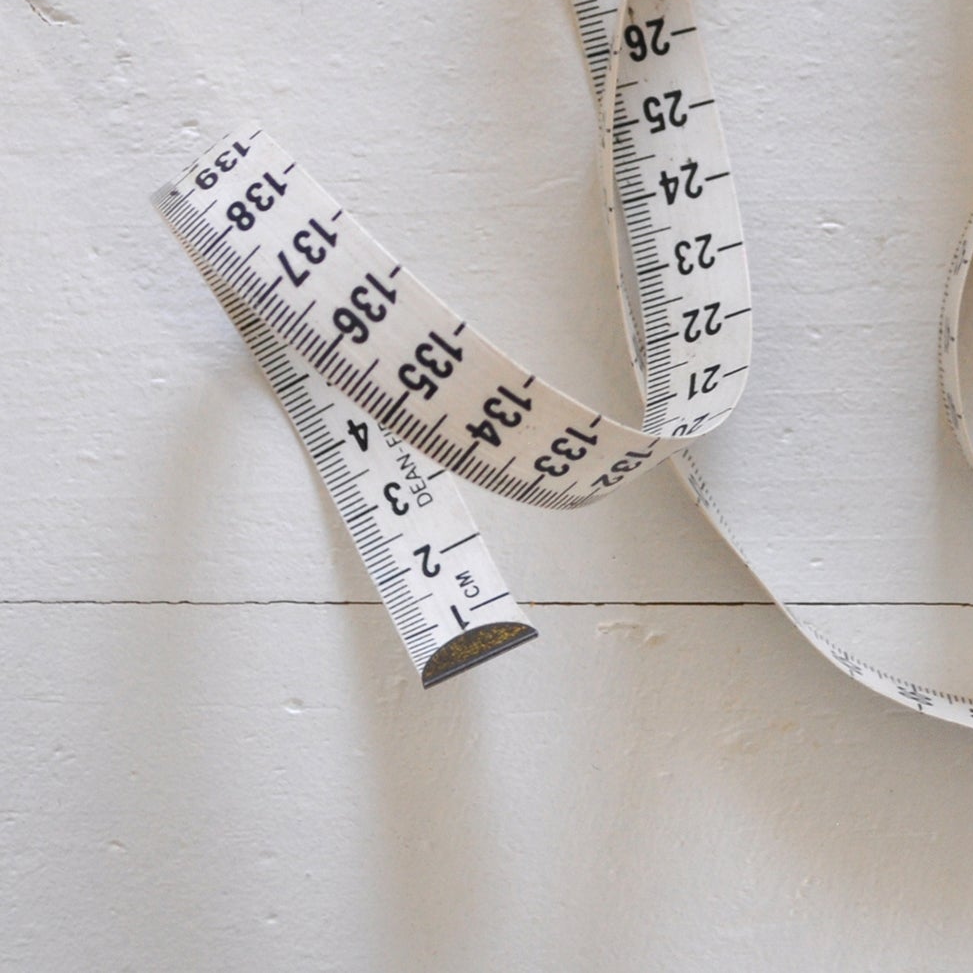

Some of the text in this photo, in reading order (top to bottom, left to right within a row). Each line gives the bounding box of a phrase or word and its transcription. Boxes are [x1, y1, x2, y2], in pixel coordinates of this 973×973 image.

[624, 18, 670, 62] 26
[643, 90, 687, 134] 25
[195, 141, 251, 190] 139
[659, 162, 703, 205] 24
[226, 172, 287, 232] 138
[277, 218, 338, 288] 137
[674, 234, 715, 276] 23
[332, 273, 397, 344] 136
[682, 302, 722, 343] 22
[398, 331, 463, 401] 135
[687, 364, 721, 401] 21
[347, 419, 369, 452] 4
[466, 386, 532, 447] 134
[534, 427, 598, 477] 133
[591, 451, 652, 486] 132
[383, 482, 410, 516] 3
[412, 543, 441, 578] 2
[455, 570, 480, 598] CM
[450, 604, 470, 630] 1
